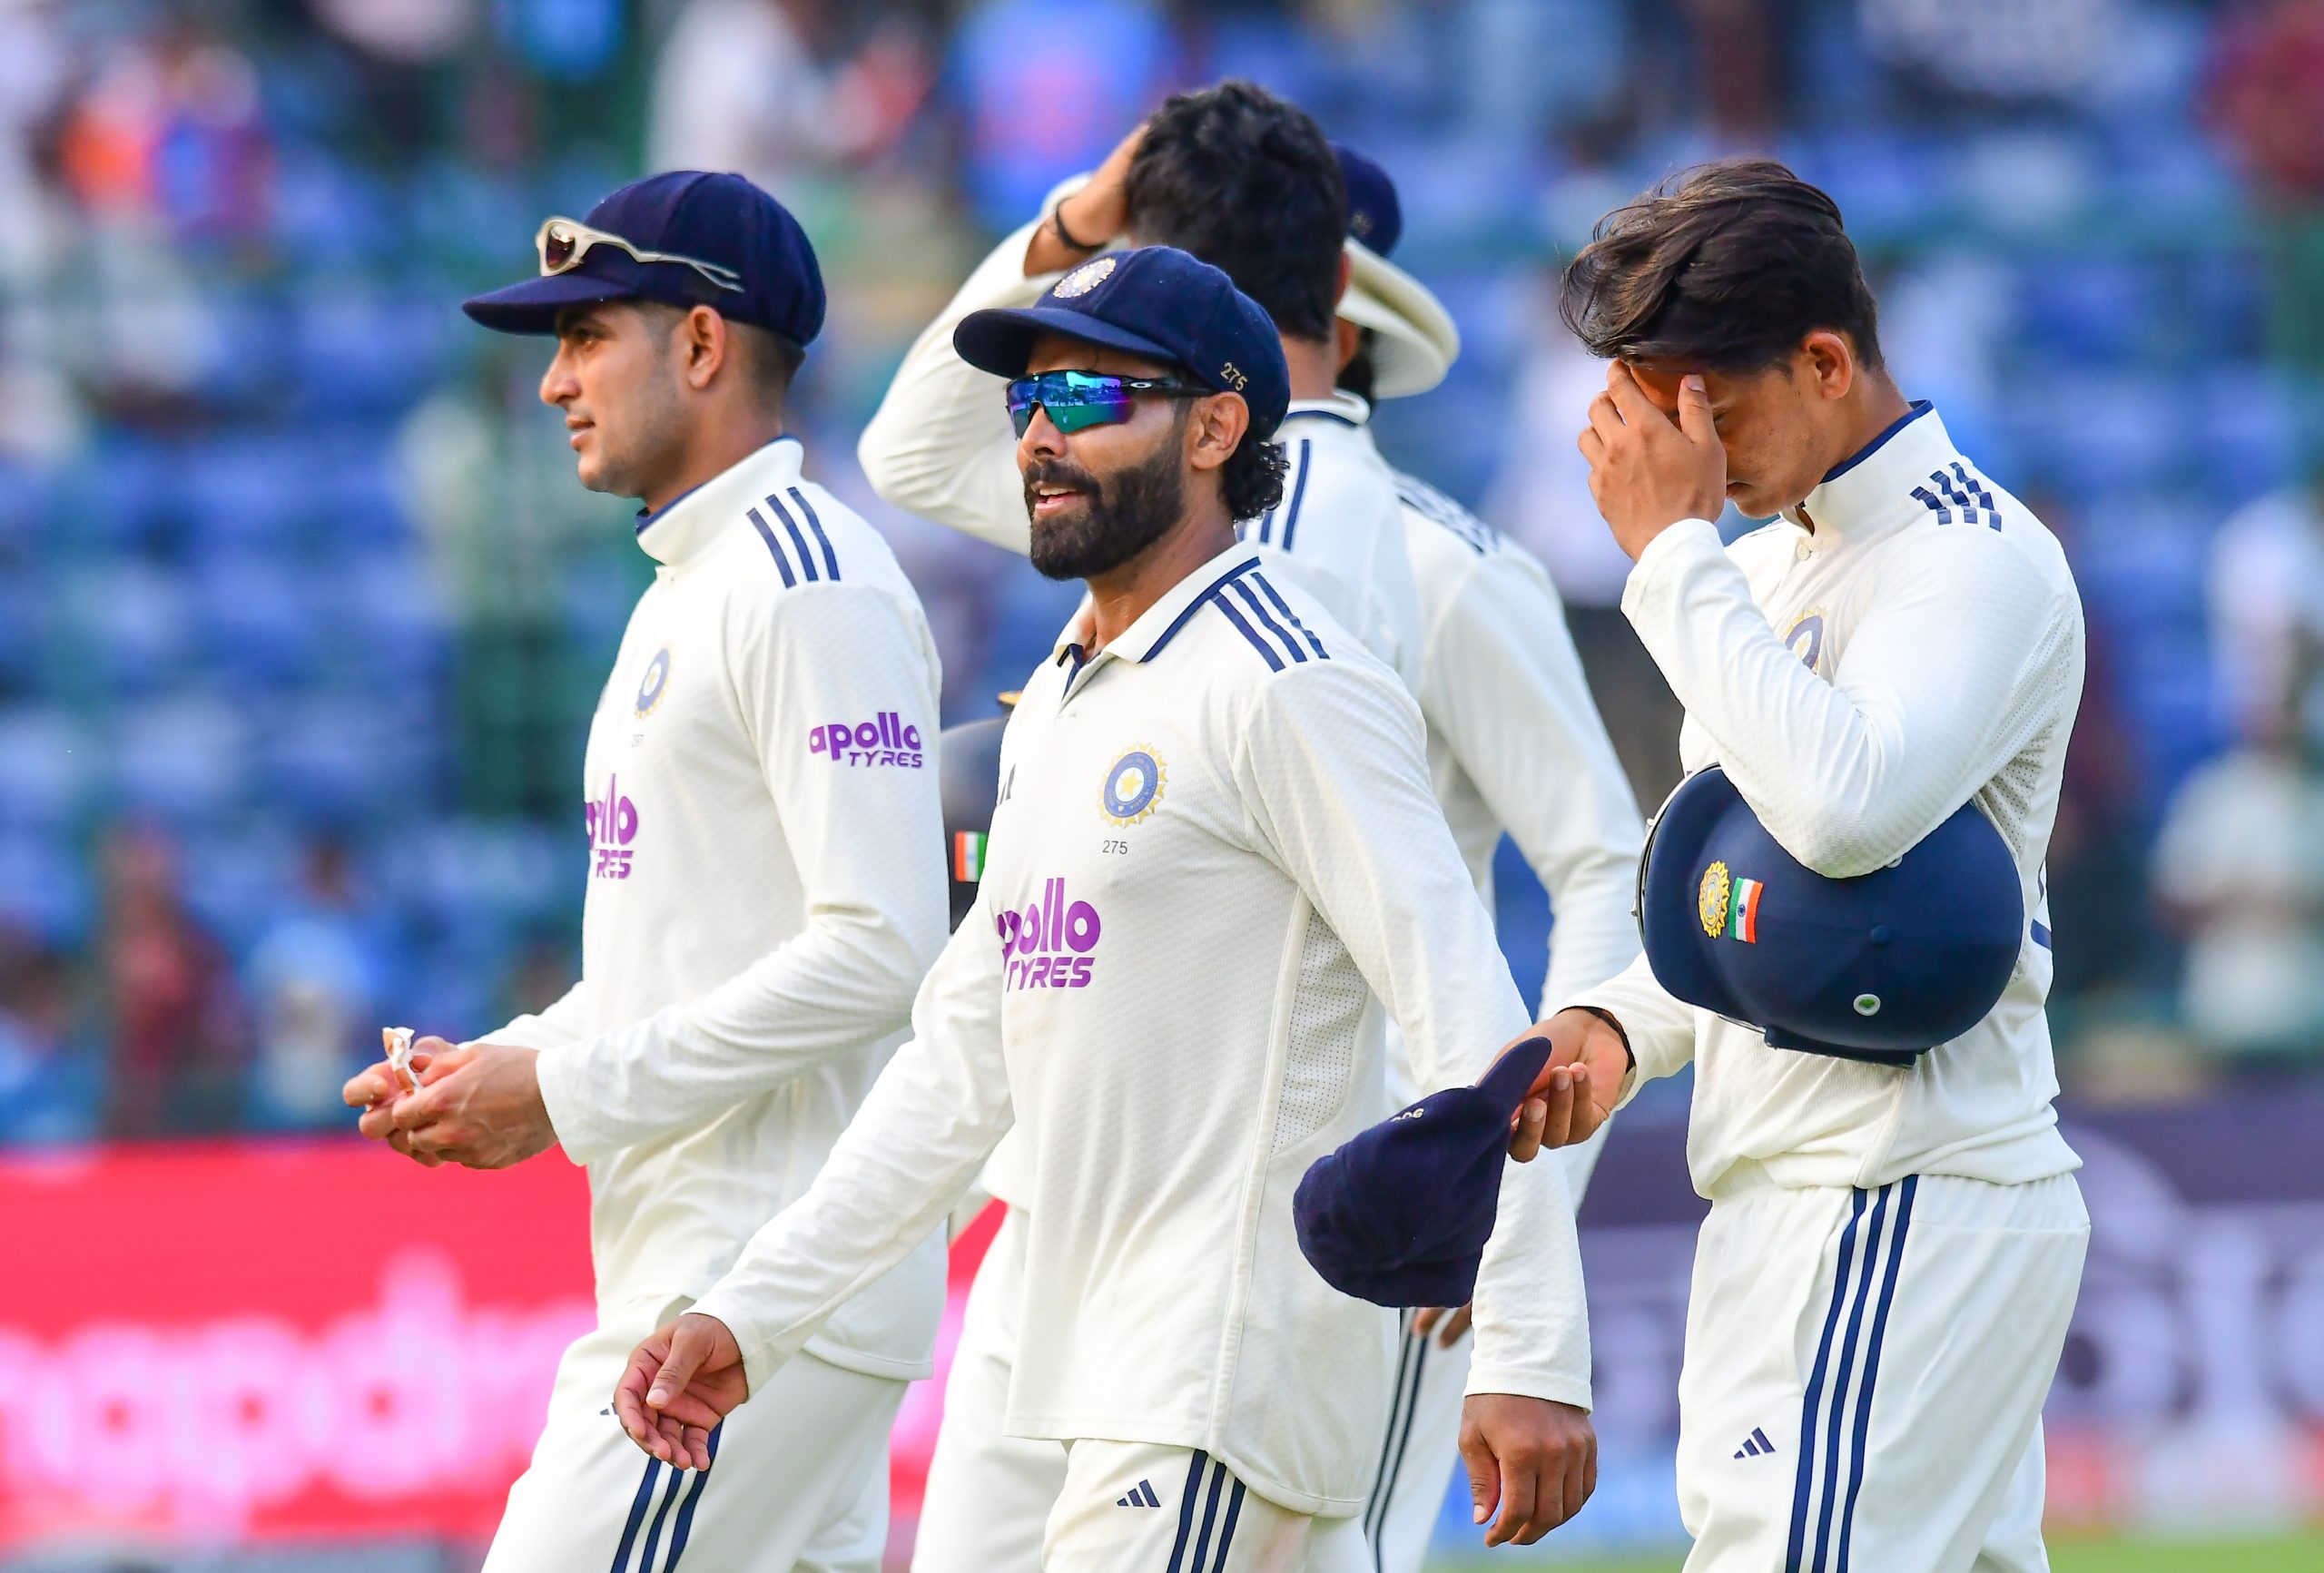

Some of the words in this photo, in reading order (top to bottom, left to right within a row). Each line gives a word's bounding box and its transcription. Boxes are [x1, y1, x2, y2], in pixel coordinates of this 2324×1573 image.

[1220, 362, 1248, 391] 275
[810, 712, 921, 761] apollo
[849, 750, 922, 769] TYRES
[1102, 840, 1128, 855] 275
[596, 849, 635, 879] RES
[997, 877, 1101, 974] pollo
